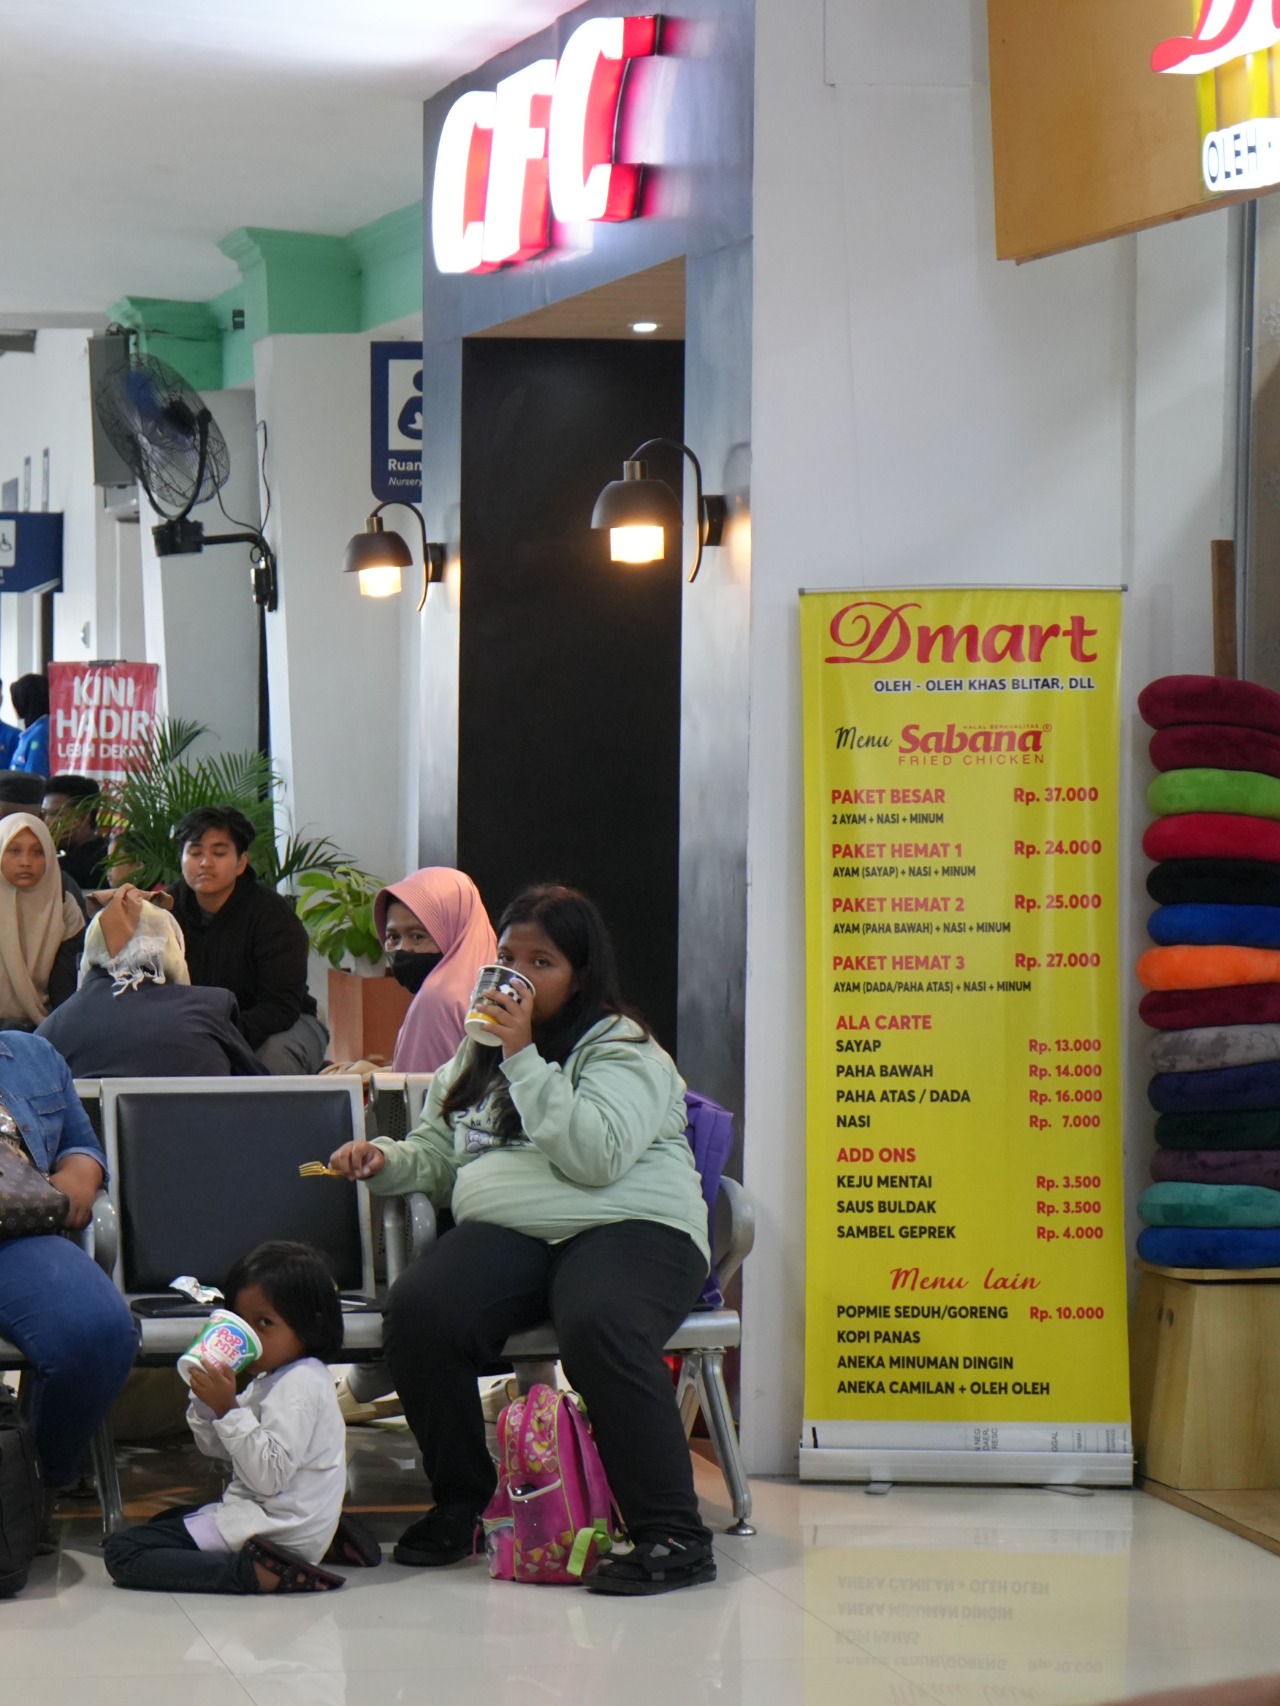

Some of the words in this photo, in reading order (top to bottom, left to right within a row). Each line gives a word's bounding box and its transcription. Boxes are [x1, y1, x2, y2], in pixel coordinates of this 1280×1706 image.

[432, 14, 658, 274] CFC
[1208, 127, 1258, 184] OLEH
[388, 458, 422, 472] Ruan
[824, 601, 1098, 664] Dmart
[73, 675, 135, 708] KINI
[874, 679, 912, 693] OLEH
[925, 679, 963, 692] OLEH
[968, 678, 1006, 691] KHAS
[1011, 677, 1064, 691] BLITAR,
[1069, 677, 1094, 690] DLL
[56, 708, 151, 741] HADIR
[835, 726, 893, 750] Menu
[898, 723, 1043, 754] Sabana
[898, 755, 953, 766] FRIED
[963, 753, 1045, 766] CHICKEN
[831, 789, 885, 804] PAKET
[890, 788, 945, 803] BESAR
[1014, 788, 1040, 806] Rp.
[1044, 787, 1098, 802] 37.000
[832, 814, 838, 825] 2
[840, 814, 867, 824] AYAM
[877, 814, 899, 825] NASI
[910, 813, 944, 823] MINUM
[832, 844, 886, 859] PAKET
[891, 843, 950, 858] HEMAT
[955, 843, 962, 857] 1
[1014, 840, 1040, 859] Rp.
[1045, 840, 1102, 855] 24.000
[833, 867, 860, 878] AYAM
[862, 867, 898, 879] (SAYAP)
[909, 866, 931, 877] NASI
[942, 866, 976, 877] MINUM
[832, 898, 886, 913] PAKET
[891, 897, 950, 912] HEMAT
[955, 897, 964, 912] 2
[1015, 894, 1041, 913] Rp.
[1045, 894, 1102, 909] 25.000
[833, 923, 860, 934] AYAM
[862, 923, 892, 935] (PAHA
[894, 922, 933, 935] BAWAH)
[943, 922, 966, 933] NASI
[977, 922, 1011, 933] MINUM
[833, 956, 887, 971] PAKET
[892, 956, 951, 970] HEMAT
[956, 955, 965, 970] 3
[1015, 953, 1042, 972] Rp.
[1046, 953, 1101, 968] 27.000
[833, 982, 860, 993] AYAM
[863, 981, 924, 994] (DADA/PAHA
[926, 981, 953, 994] ATAS)
[964, 982, 986, 992] NASI
[997, 981, 1031, 992] MINUM
[836, 1016, 871, 1030] ALA
[875, 1016, 932, 1030] CARTE
[836, 1040, 881, 1053] SAYAP
[1029, 1039, 1051, 1055] Rp.
[1055, 1039, 1101, 1052] 13.000
[836, 1065, 876, 1078] PAHA
[880, 1065, 933, 1078] BAWAH
[1029, 1064, 1051, 1080] Rp.
[1055, 1064, 1102, 1077] 14.000
[836, 1090, 876, 1103] PAHA
[880, 1090, 916, 1103] ATAS
[930, 1090, 971, 1103] DADA
[1029, 1090, 1052, 1106] Rp.
[1055, 1090, 1102, 1103] 16.000
[837, 1116, 871, 1128] NASI
[1029, 1116, 1052, 1131] Rp.
[1062, 1115, 1101, 1128] 7.000
[837, 1148, 874, 1162] ADD
[878, 1148, 916, 1162] ONS
[837, 1175, 873, 1188] KEJU
[877, 1175, 932, 1188] MENTAI
[1036, 1176, 1059, 1192] Rp.
[1063, 1176, 1101, 1189] 3.500
[837, 1201, 874, 1214] SAUS
[878, 1201, 936, 1214] BULDAK
[1036, 1201, 1059, 1217] Rp.
[1063, 1201, 1101, 1214] 3.500
[837, 1226, 895, 1239] SAMBEL
[899, 1226, 956, 1239] GEPREK
[1037, 1227, 1060, 1242] Rp.
[1063, 1227, 1103, 1240] 4.000
[890, 1267, 969, 1291] Menu
[983, 1268, 1041, 1290] lain
[837, 1305, 891, 1319] POPMIE
[894, 1305, 1008, 1320] SEDUH/GORENG
[1030, 1306, 1052, 1323] Rp.
[1056, 1306, 1104, 1319] 10.000
[215, 1327, 244, 1347] POP
[837, 1331, 870, 1344] KOPI
[874, 1331, 921, 1344] PANAS
[837, 1356, 886, 1369] ANEKA
[889, 1357, 959, 1369] MINUMAN
[963, 1357, 1013, 1369] DINGIN
[837, 1381, 886, 1395] ANEKA
[889, 1381, 955, 1395] CAMILAN
[970, 1382, 1008, 1395] OLEH
[1012, 1382, 1050, 1395] OLEH
